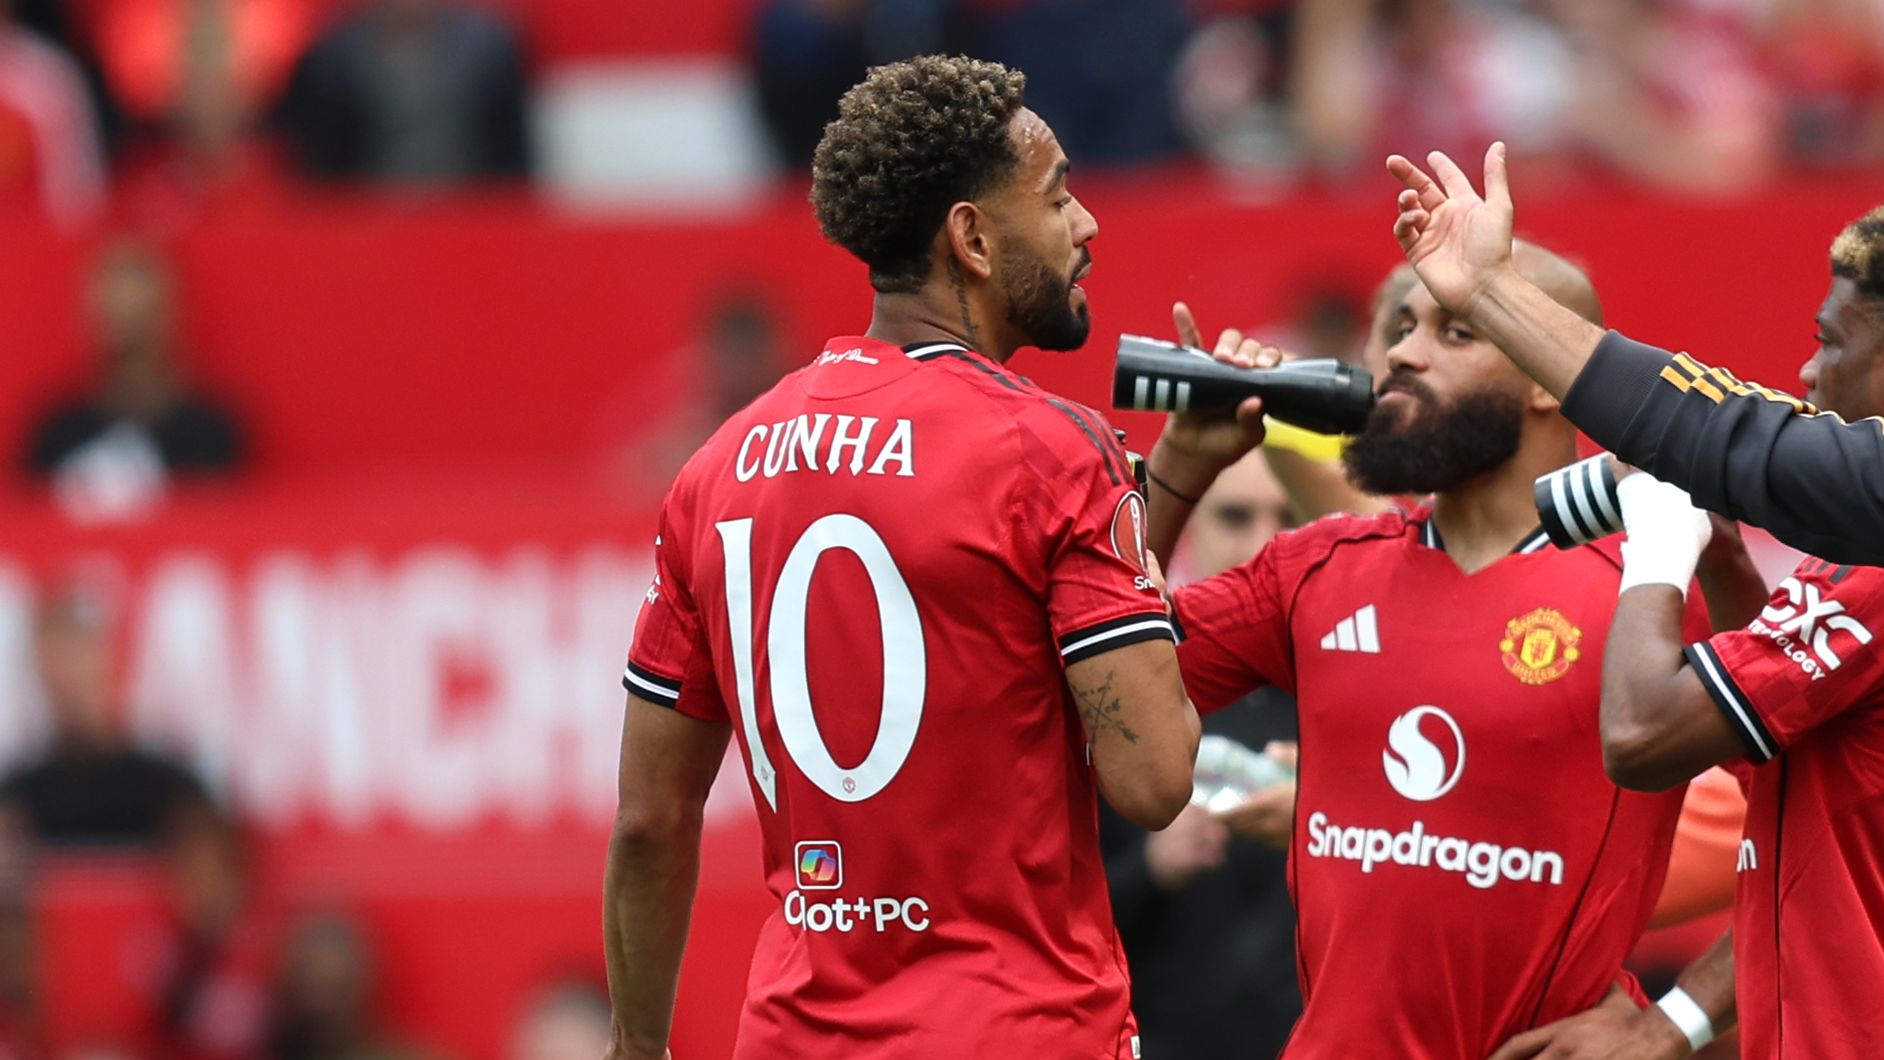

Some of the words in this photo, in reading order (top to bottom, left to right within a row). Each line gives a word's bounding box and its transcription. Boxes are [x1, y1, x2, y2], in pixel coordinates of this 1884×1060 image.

[735, 413, 915, 483] CUNHA
[714, 512, 927, 813] 10
[1307, 812, 1564, 889] Snapdragon
